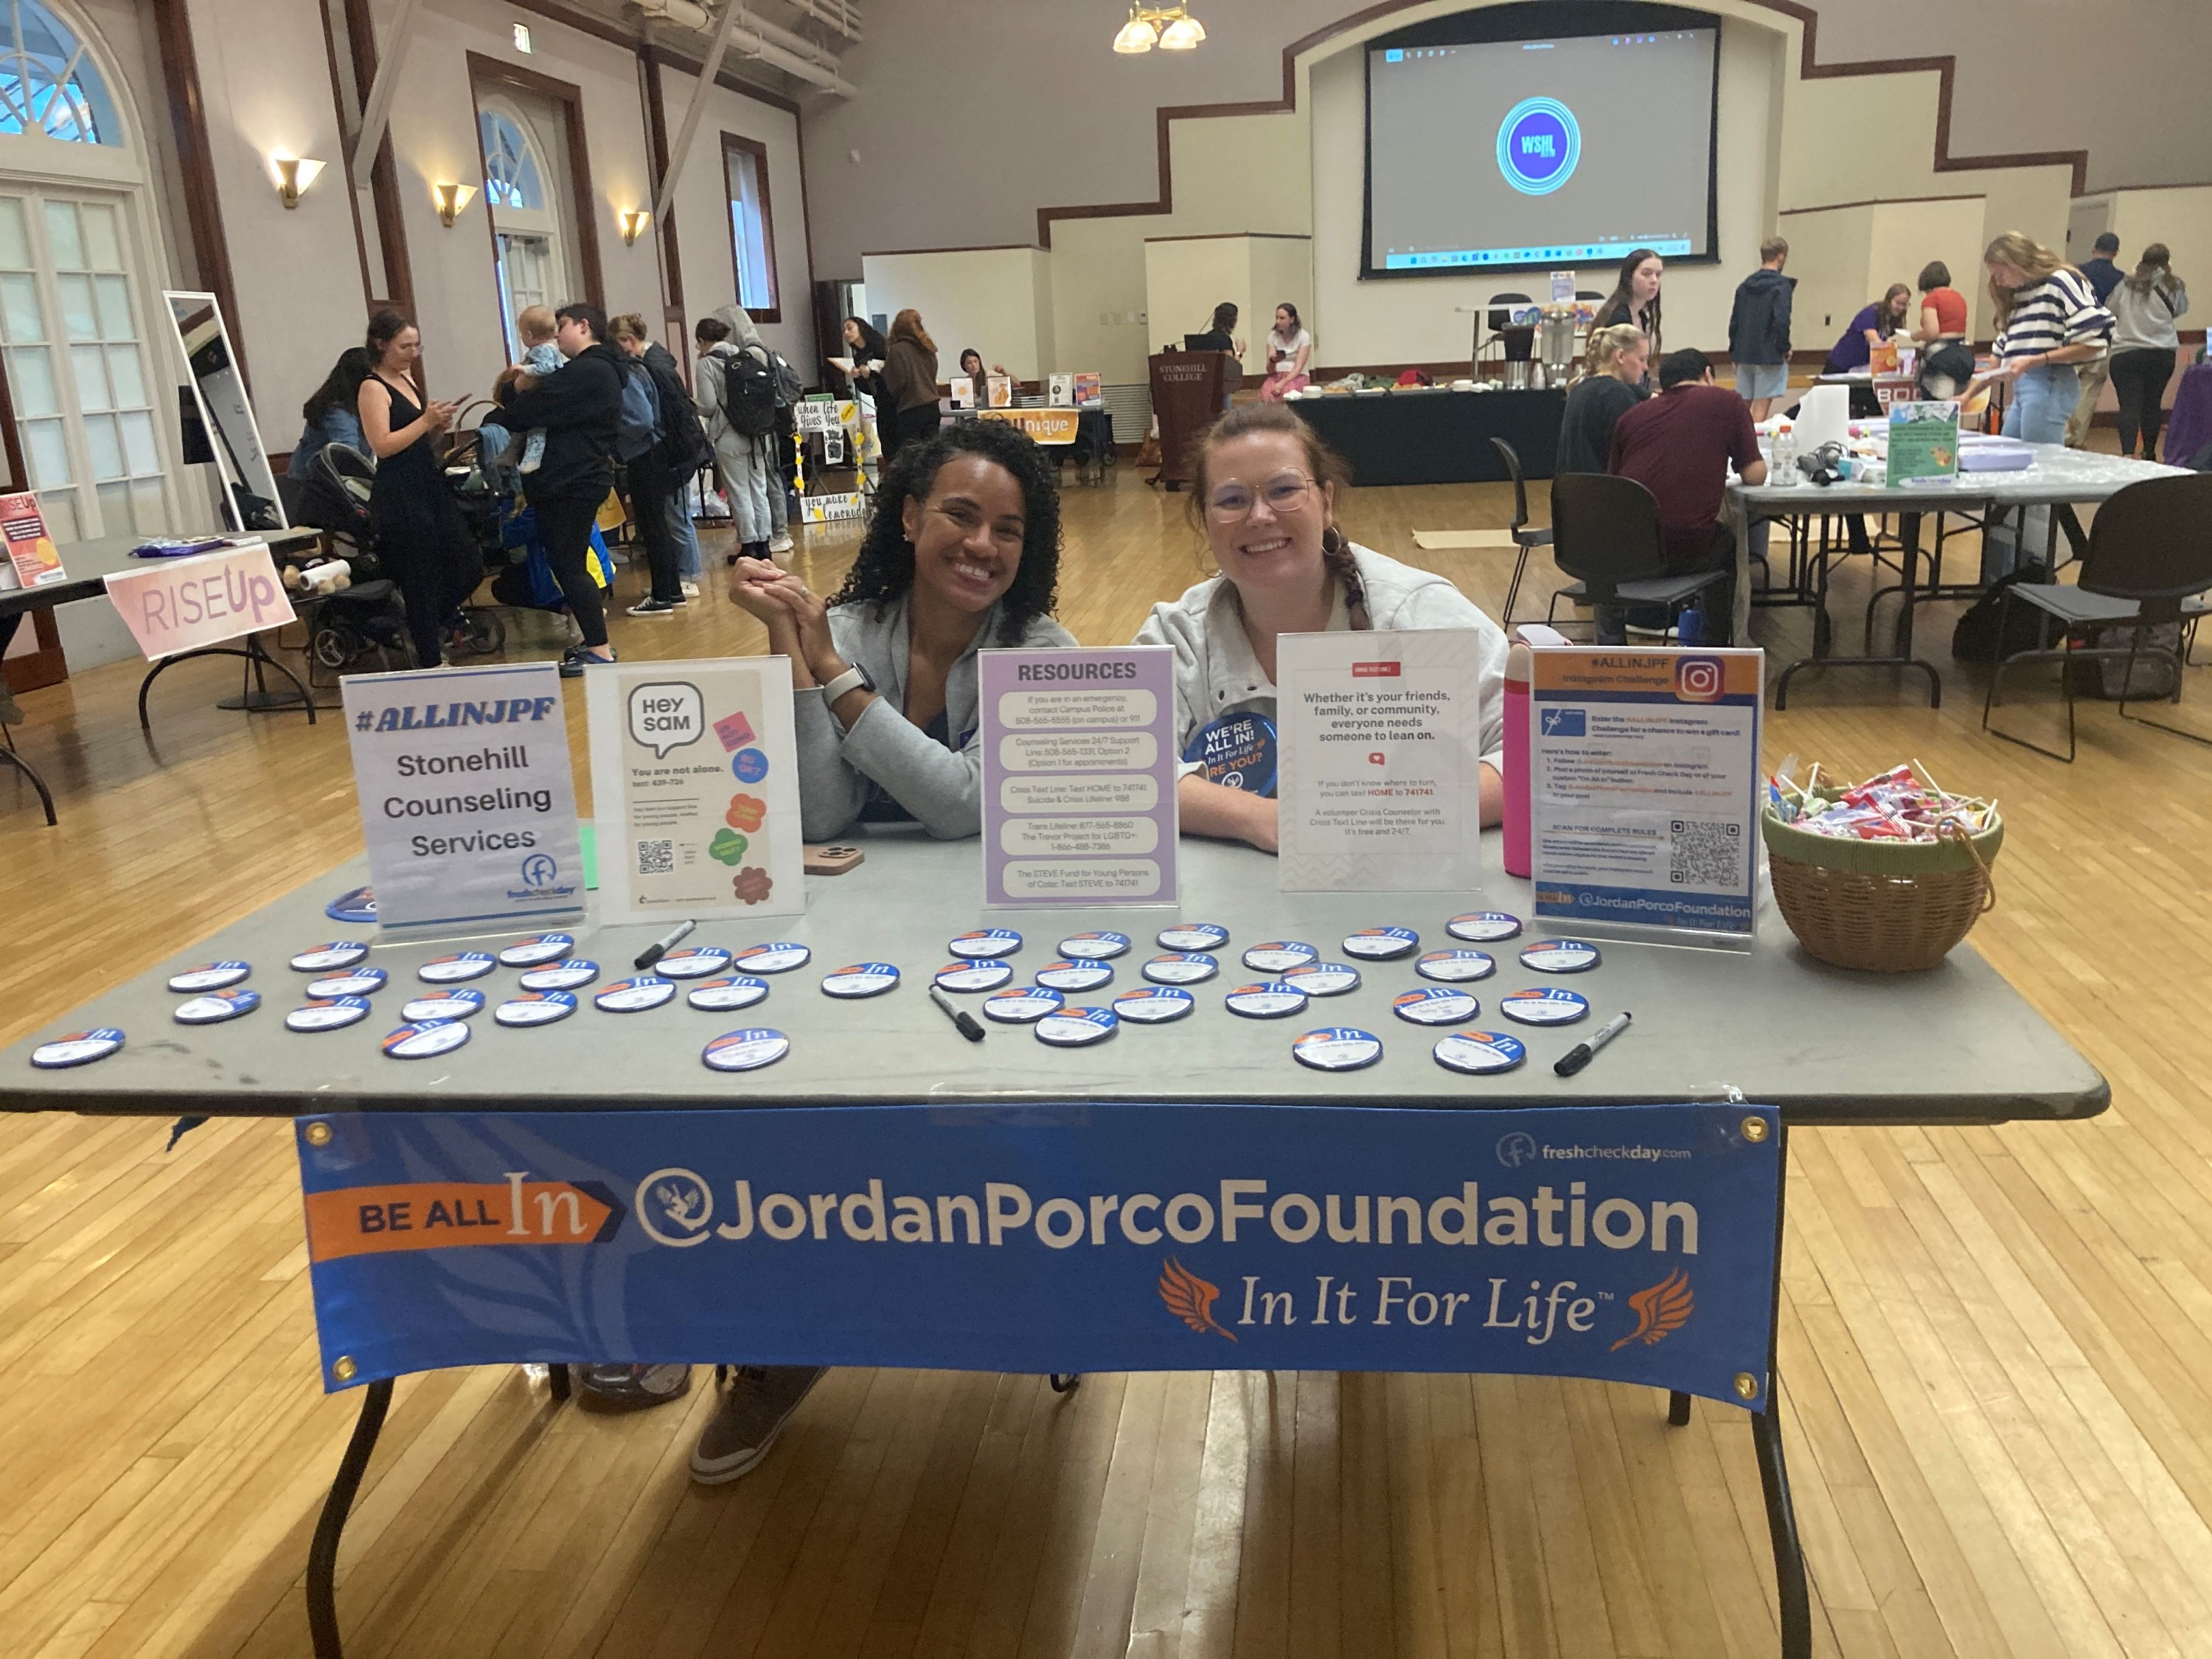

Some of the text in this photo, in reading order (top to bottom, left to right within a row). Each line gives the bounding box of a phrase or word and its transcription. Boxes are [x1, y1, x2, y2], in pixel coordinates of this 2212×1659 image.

[1158, 364, 1208, 375] STONEHILL
[1163, 372, 1203, 382] COLLEGE
[1592, 658, 1670, 669] #ALLINJPF
[1018, 662, 1136, 681] RESOURCES
[1615, 674, 1670, 686] Challenge
[1304, 691, 1450, 704] Whether it's your friends,
[355, 697, 555, 733] #ALLINJPF
[1059, 706, 1091, 714] Campus
[1092, 705, 1115, 713] Police
[1314, 704, 1440, 717] family, or community,
[1072, 716, 1085, 725] (on
[1086, 716, 1119, 725] campus)
[1130, 714, 1141, 723] 911
[1331, 717, 1423, 730] everyone needs
[1206, 719, 1253, 743] WE'RE
[1319, 730, 1436, 742] someone to lean on.
[1205, 730, 1255, 756] ALL IN!
[1208, 745, 1254, 765] In It For Life
[397, 746, 529, 777] Stonehill
[1209, 752, 1264, 778] RE YOU?
[632, 765, 724, 777] You are not alone.
[1069, 785, 1085, 793] Text
[1087, 785, 1112, 793] HOME
[1122, 784, 1147, 792] 741741
[1325, 781, 1340, 789] you
[1361, 779, 1382, 787] know
[1383, 779, 1408, 787] where
[1409, 779, 1417, 787] to
[1027, 796, 1055, 804] Suicide
[1114, 794, 1130, 802] 988
[1320, 790, 1334, 799] you
[1351, 789, 1366, 797] text
[1368, 789, 1394, 797] HOME
[383, 787, 552, 819] Counseling
[1359, 808, 1382, 816] Crisis
[1382, 808, 1422, 816] Counselor
[1423, 807, 1441, 815] with
[1028, 822, 1048, 830] Trans
[1310, 818, 1332, 827] Crisis
[1332, 818, 1350, 827] Text
[1351, 818, 1368, 826] Line
[1368, 818, 1382, 826] will
[1383, 818, 1394, 826] be
[1395, 818, 1416, 826] there
[1418, 818, 1429, 826] for
[1022, 832, 1037, 841] The
[1038, 832, 1062, 841] Trevor
[1063, 832, 1090, 841] Project
[1091, 832, 1102, 840] for
[1357, 827, 1374, 835] free
[1375, 827, 1390, 835] and
[411, 831, 536, 857] Services
[1018, 869, 1149, 879] The STEVE Fund for Young Persons
[1079, 880, 1104, 888] STEVE
[1114, 879, 1138, 887] 741741
[1579, 892, 1750, 919] @JordanPorcoFoundation
[989, 929, 1012, 938] In
[1199, 925, 1220, 933] In
[1386, 927, 1410, 937] In
[768, 943, 792, 951] In
[1559, 940, 1583, 950] In
[864, 964, 889, 973] In
[634, 977, 660, 987] In
[1266, 983, 1293, 992] In
[1029, 988, 1053, 998] In
[1155, 988, 1180, 998] In
[1425, 988, 1452, 999] In
[1545, 989, 1573, 1001] In
[1086, 1009, 1111, 1022] In
[412, 1019, 441, 1033] In
[744, 1029, 769, 1041] In
[1334, 1029, 1362, 1040] In
[1491, 1037, 1517, 1052] In
[1542, 1144, 1692, 1163] freshcheckday.com
[358, 1171, 588, 1237] BE ALL In
[636, 1166, 1699, 1255] @JordanPorcoFoundation
[1237, 1276, 1295, 1326] In
[1311, 1276, 1350, 1326] It
[1372, 1277, 1470, 1326] For
